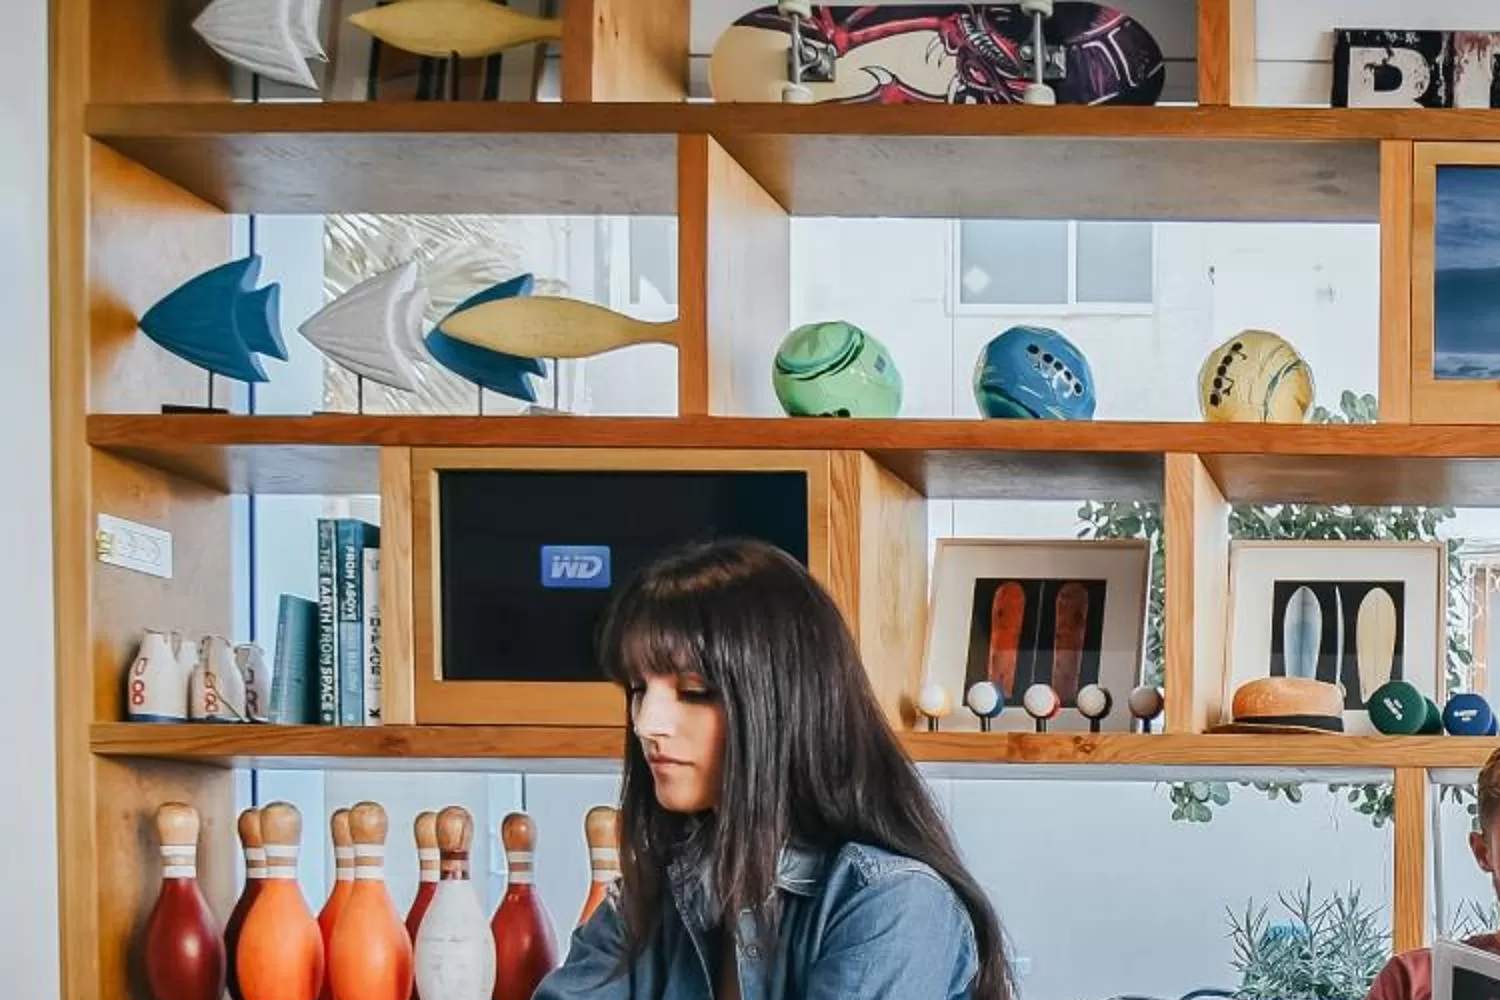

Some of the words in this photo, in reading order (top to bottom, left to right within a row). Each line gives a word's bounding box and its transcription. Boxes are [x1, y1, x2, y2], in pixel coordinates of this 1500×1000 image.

[551, 555, 603, 579] WD
[319, 576, 334, 622] EARTH
[320, 624, 335, 665] FROM
[321, 667, 336, 711] SPACE
